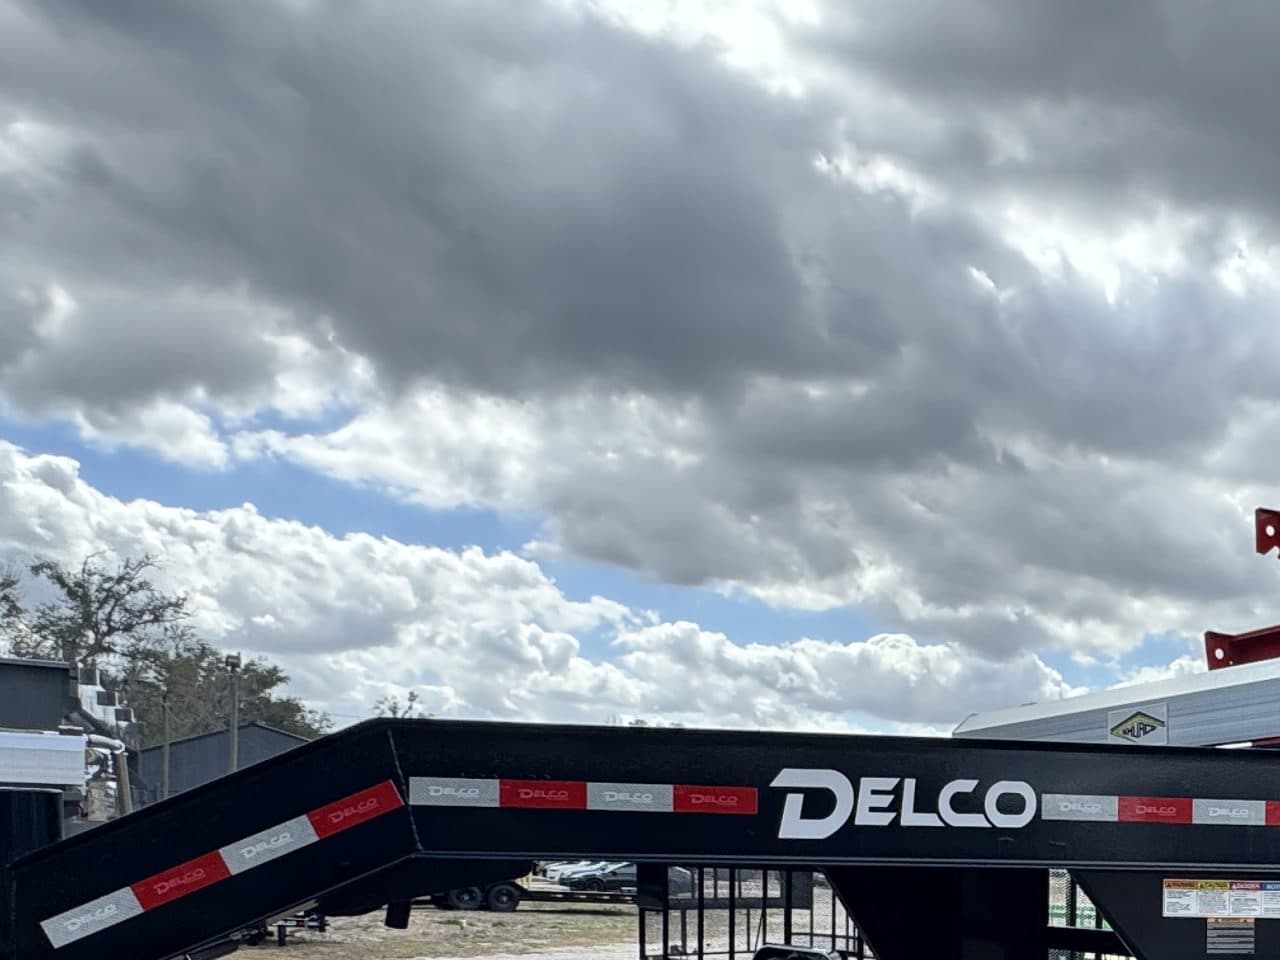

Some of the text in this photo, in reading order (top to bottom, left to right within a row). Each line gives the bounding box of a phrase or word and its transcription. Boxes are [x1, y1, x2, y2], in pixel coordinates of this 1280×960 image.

[429, 785, 479, 797] DELCO
[518, 788, 568, 799] DELCO
[603, 791, 653, 802] DELCO
[689, 794, 738, 805] DELCO
[769, 768, 1038, 840] DELCO
[328, 798, 377, 823] DELCO
[1135, 805, 1177, 815] DELCO
[1208, 807, 1249, 817] DELCO
[241, 832, 290, 859] DELCO
[153, 868, 205, 895] DELCO
[64, 903, 116, 931] DELCO
